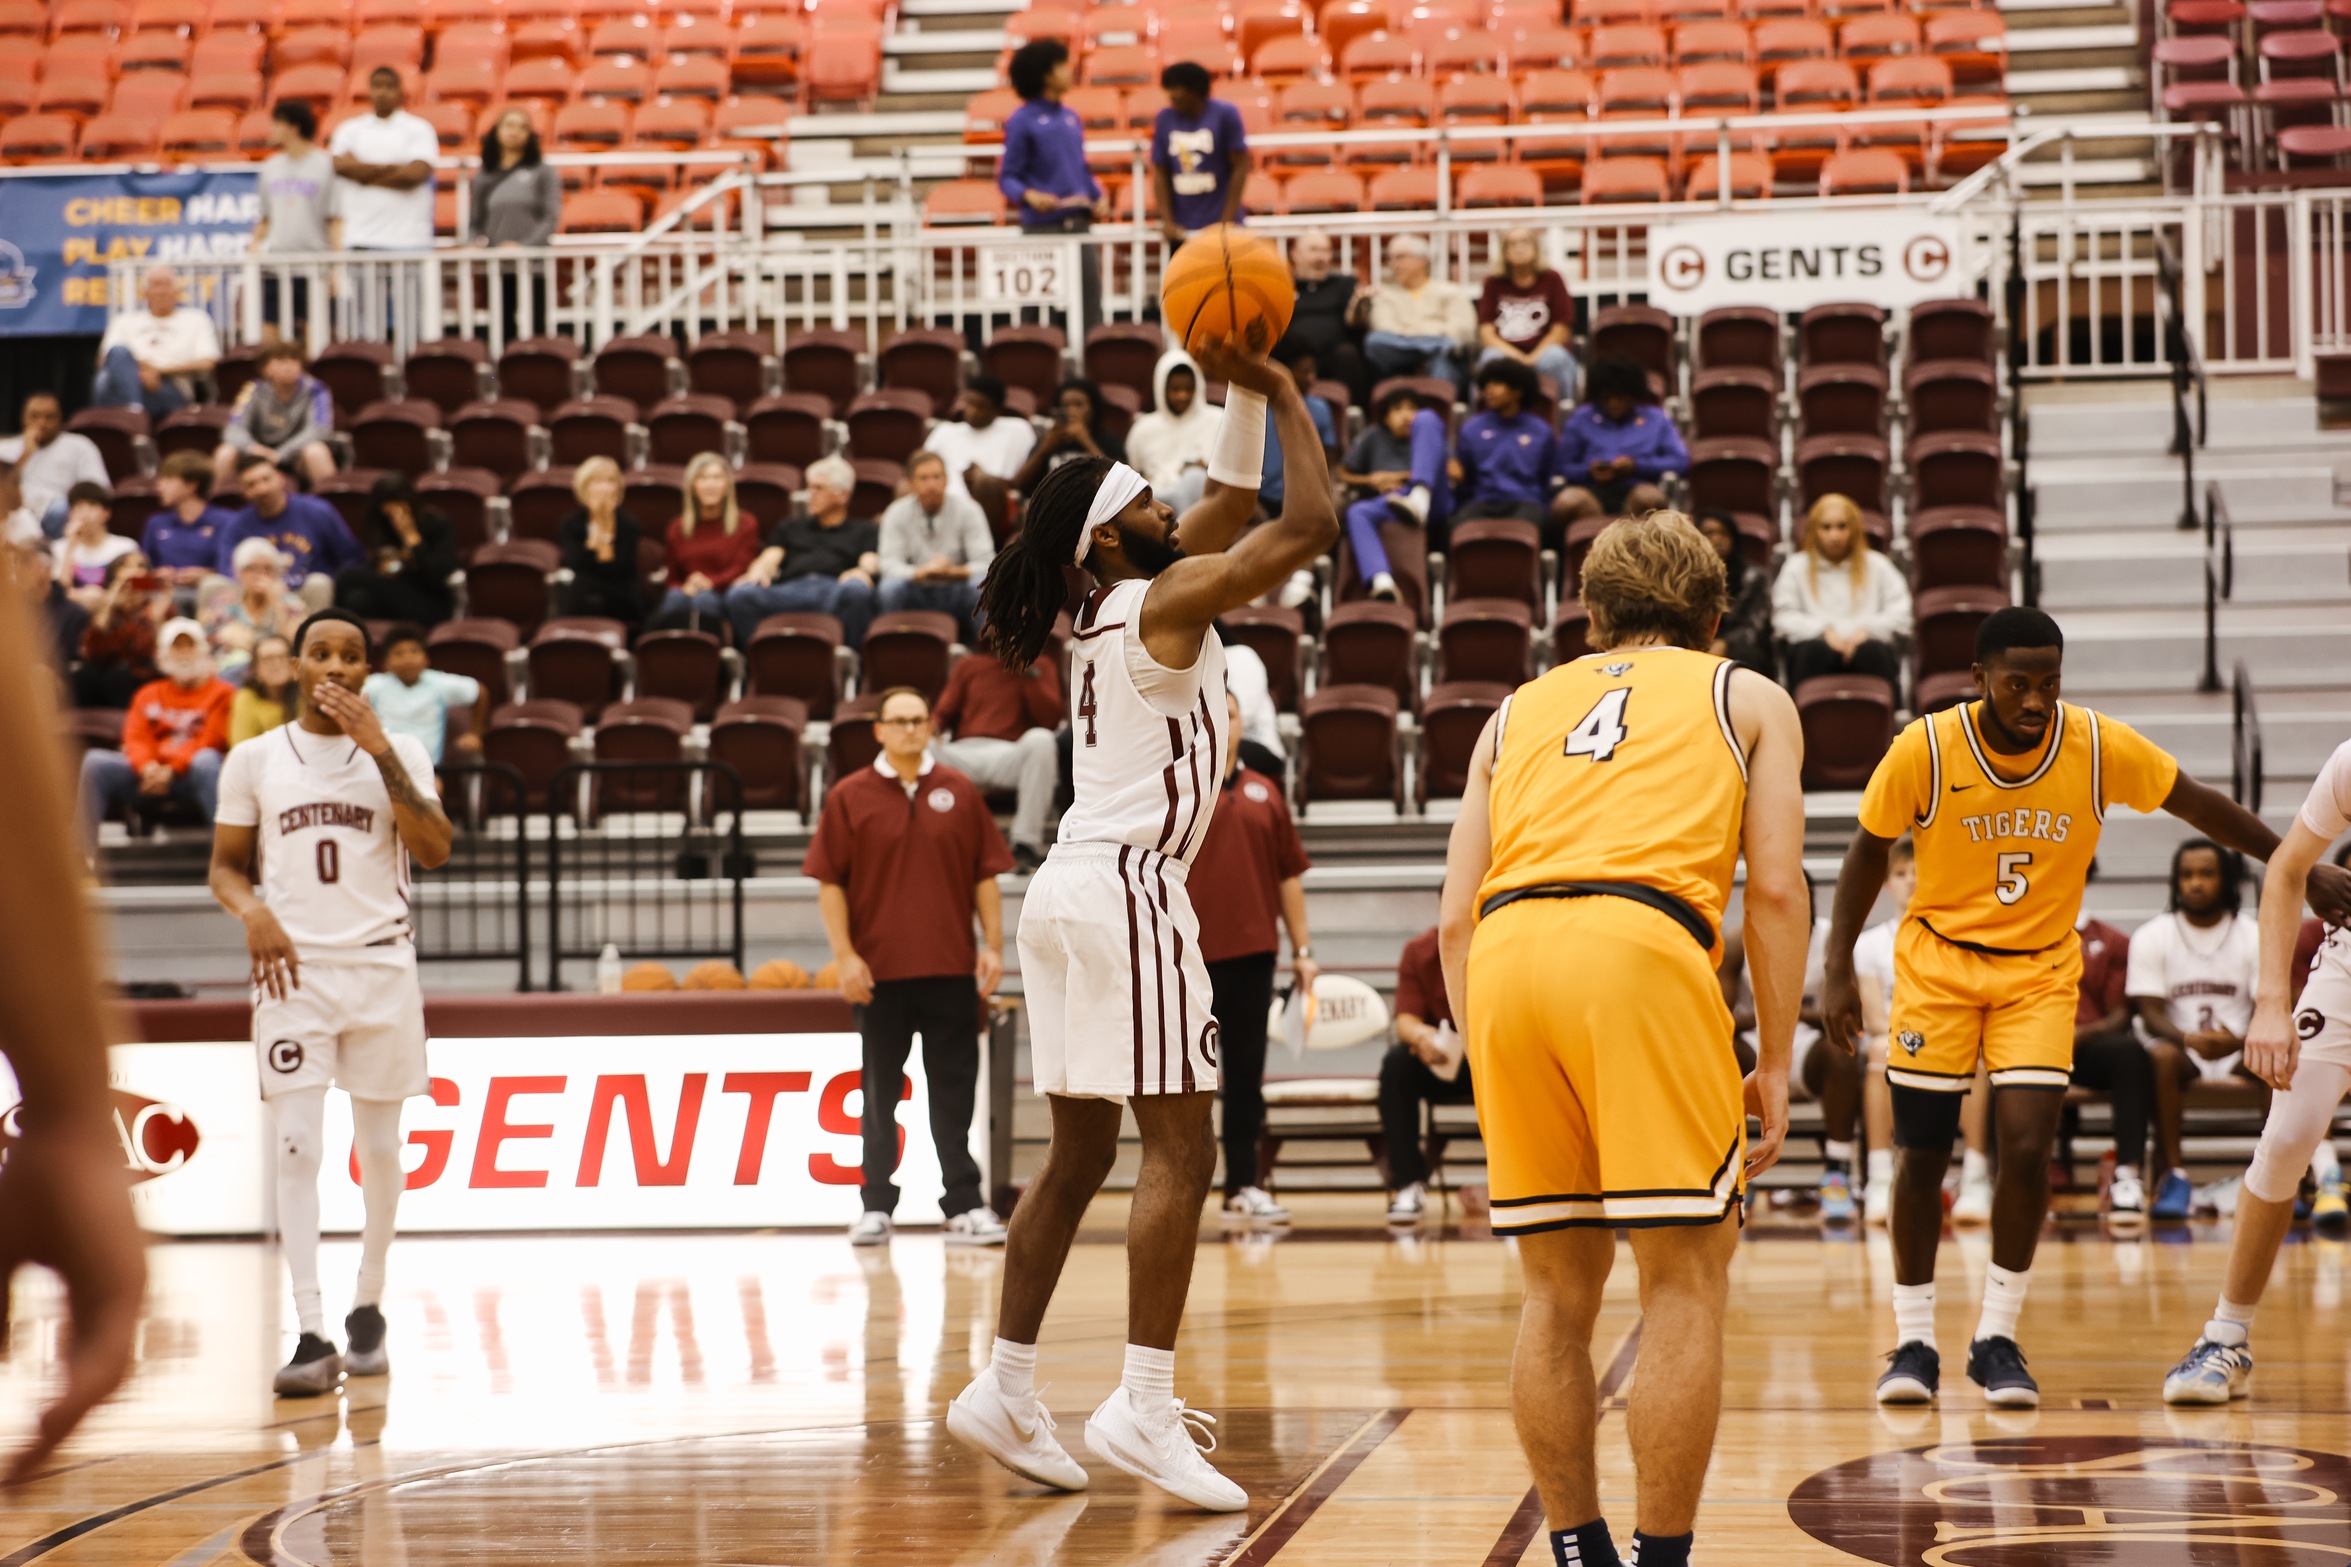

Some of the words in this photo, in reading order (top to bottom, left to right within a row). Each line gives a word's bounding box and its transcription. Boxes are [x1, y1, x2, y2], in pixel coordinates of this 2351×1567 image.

[64, 197, 182, 226] CHEER
[186, 194, 260, 225] HAR
[63, 235, 152, 265] PLAY
[157, 233, 251, 260] HAR
[1726, 245, 1883, 281] GENTS
[995, 267, 1056, 296] 102
[1078, 659, 1098, 747] 4
[1563, 686, 1633, 763] 4
[279, 802, 375, 836] CENTENARY
[1960, 807, 2072, 843] TIGERS
[316, 839, 338, 884] 0
[1995, 852, 2033, 905] 5
[349, 1070, 912, 1191] GENTS
